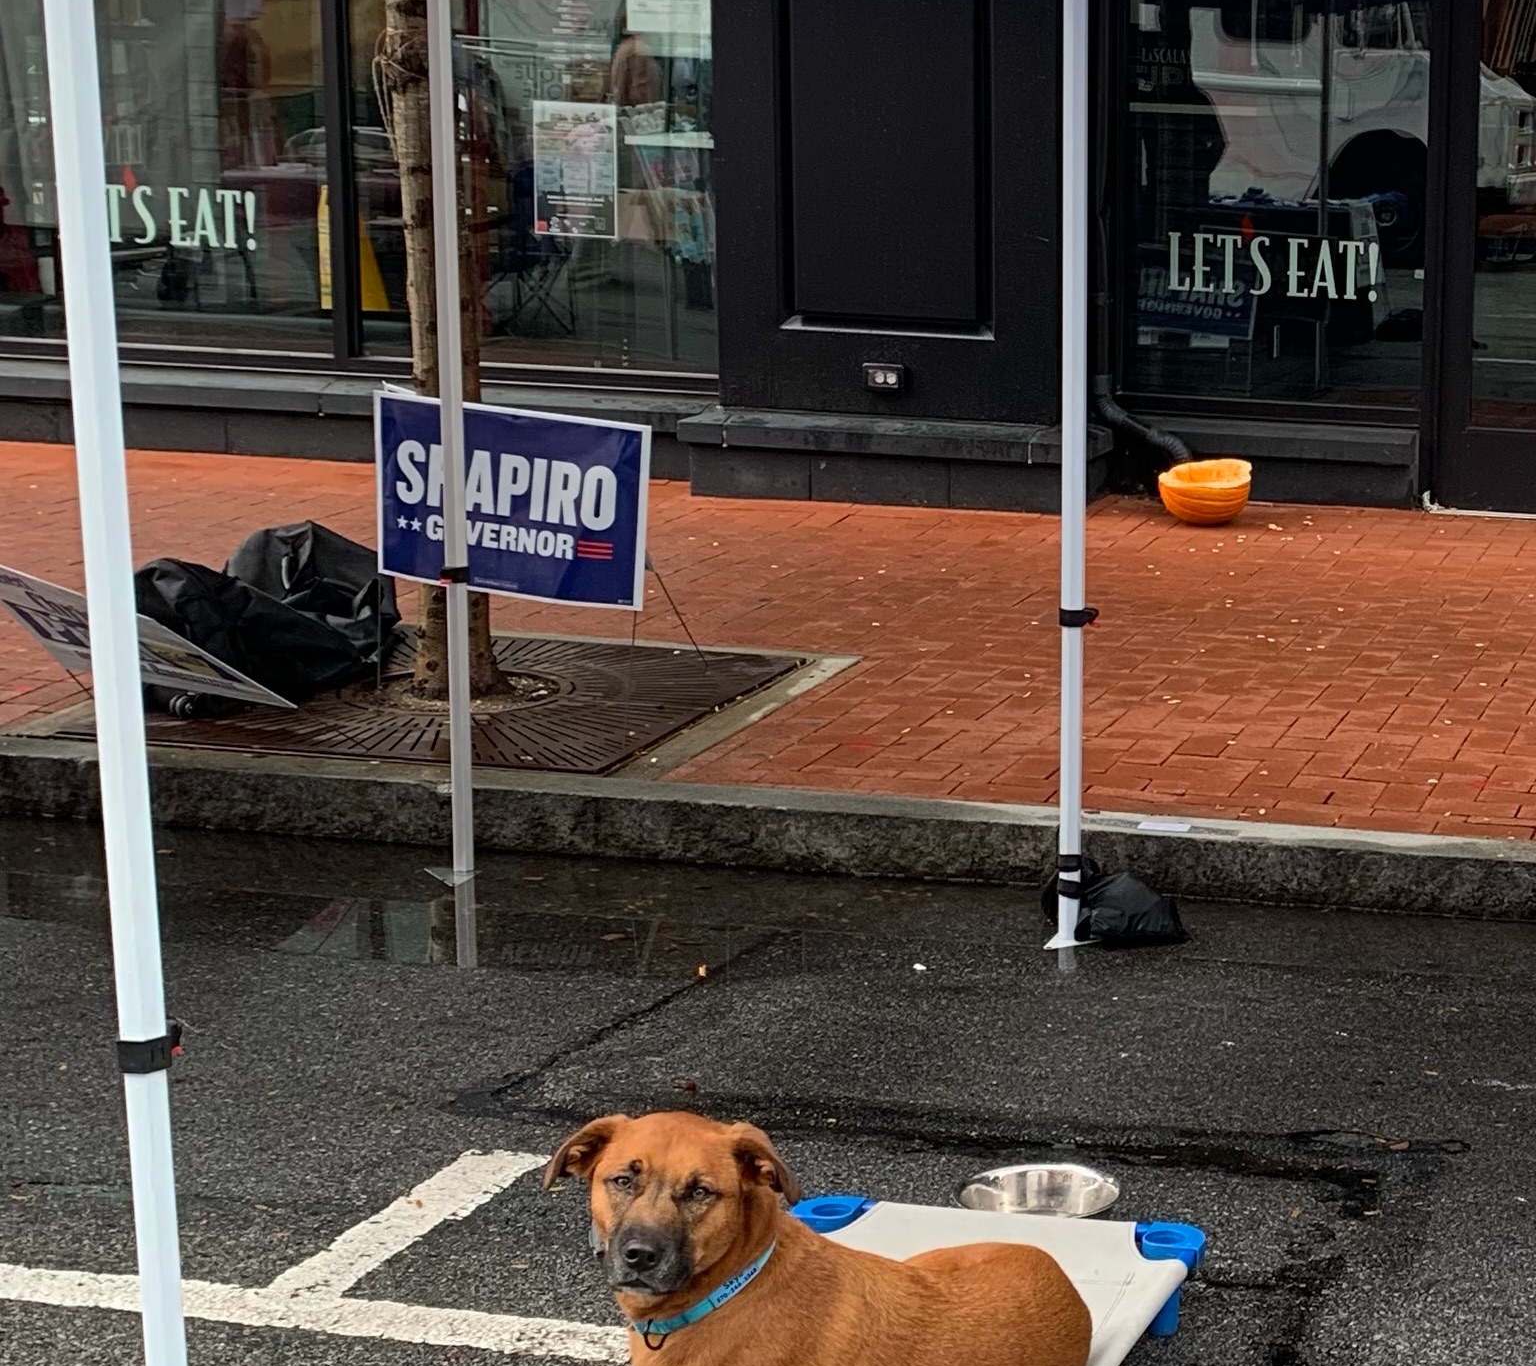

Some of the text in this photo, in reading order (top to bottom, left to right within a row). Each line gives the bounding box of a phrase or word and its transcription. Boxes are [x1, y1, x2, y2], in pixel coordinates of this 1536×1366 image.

[106, 163, 258, 251] T'S EAT!
[1167, 215, 1272, 296] LET'S
[1286, 238, 1380, 303] EAT!
[425, 514, 575, 561] GVERNOR
